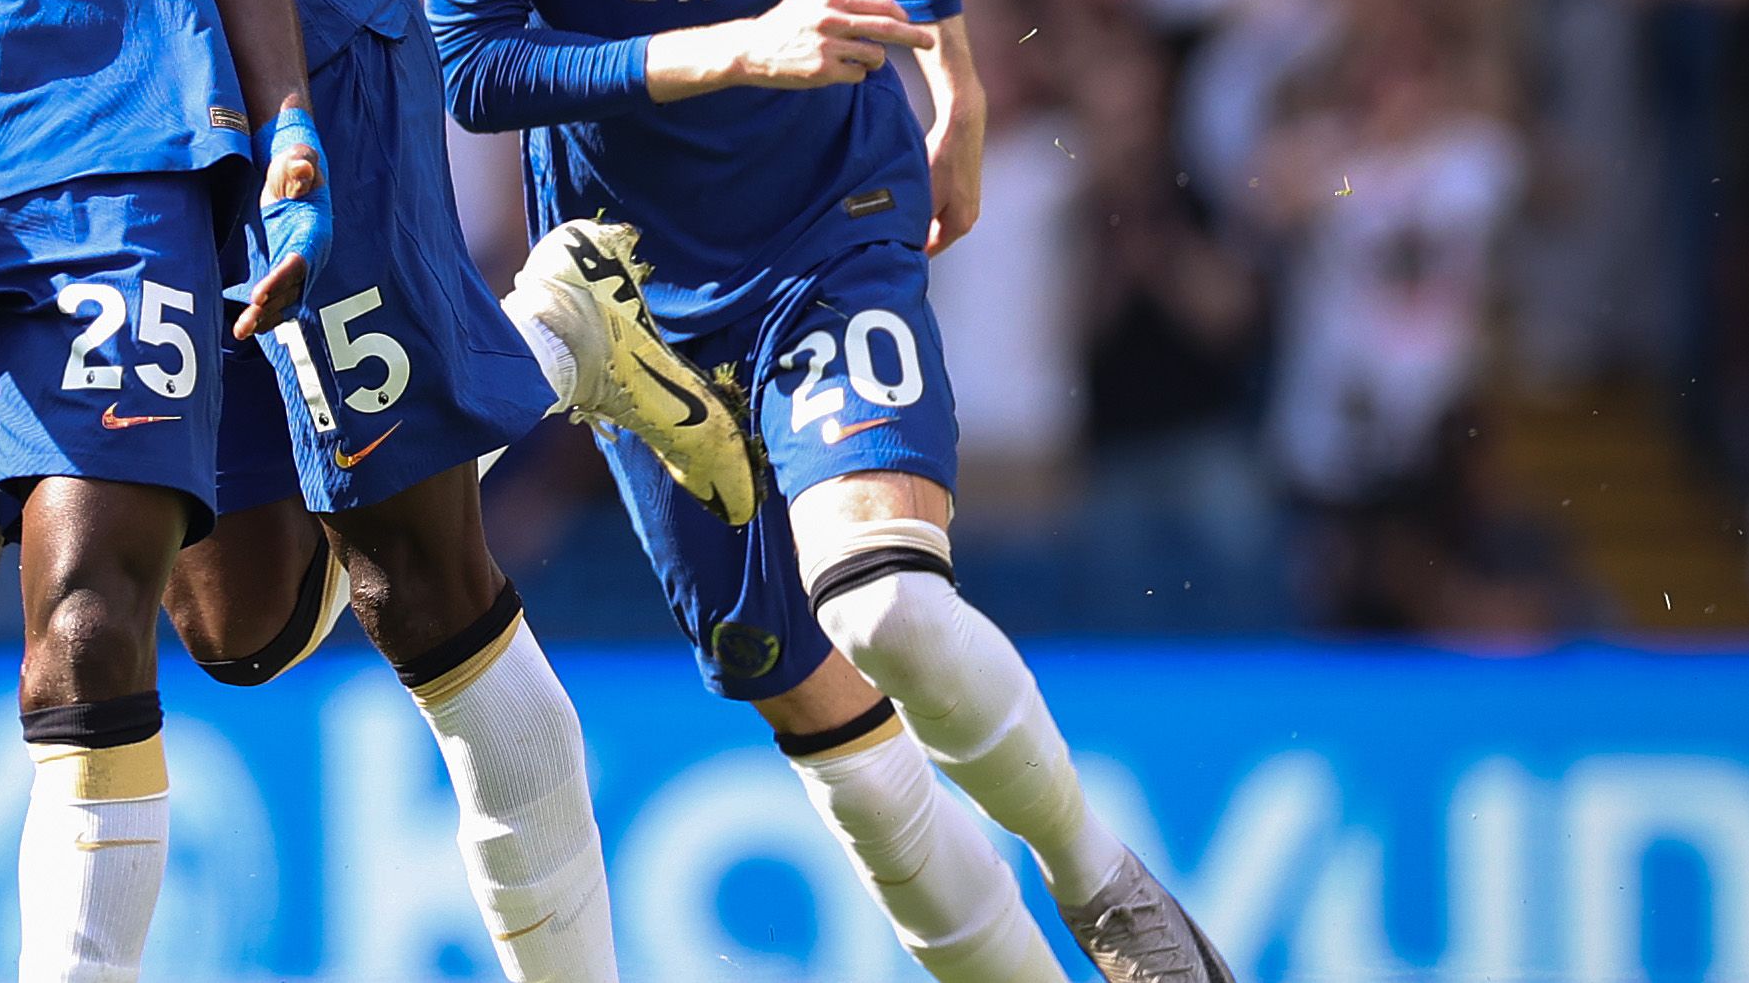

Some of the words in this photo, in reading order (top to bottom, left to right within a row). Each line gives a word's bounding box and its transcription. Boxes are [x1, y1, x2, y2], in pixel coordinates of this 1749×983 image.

[57, 279, 198, 399] 25
[274, 286, 411, 433] 15
[779, 309, 924, 434] 20
